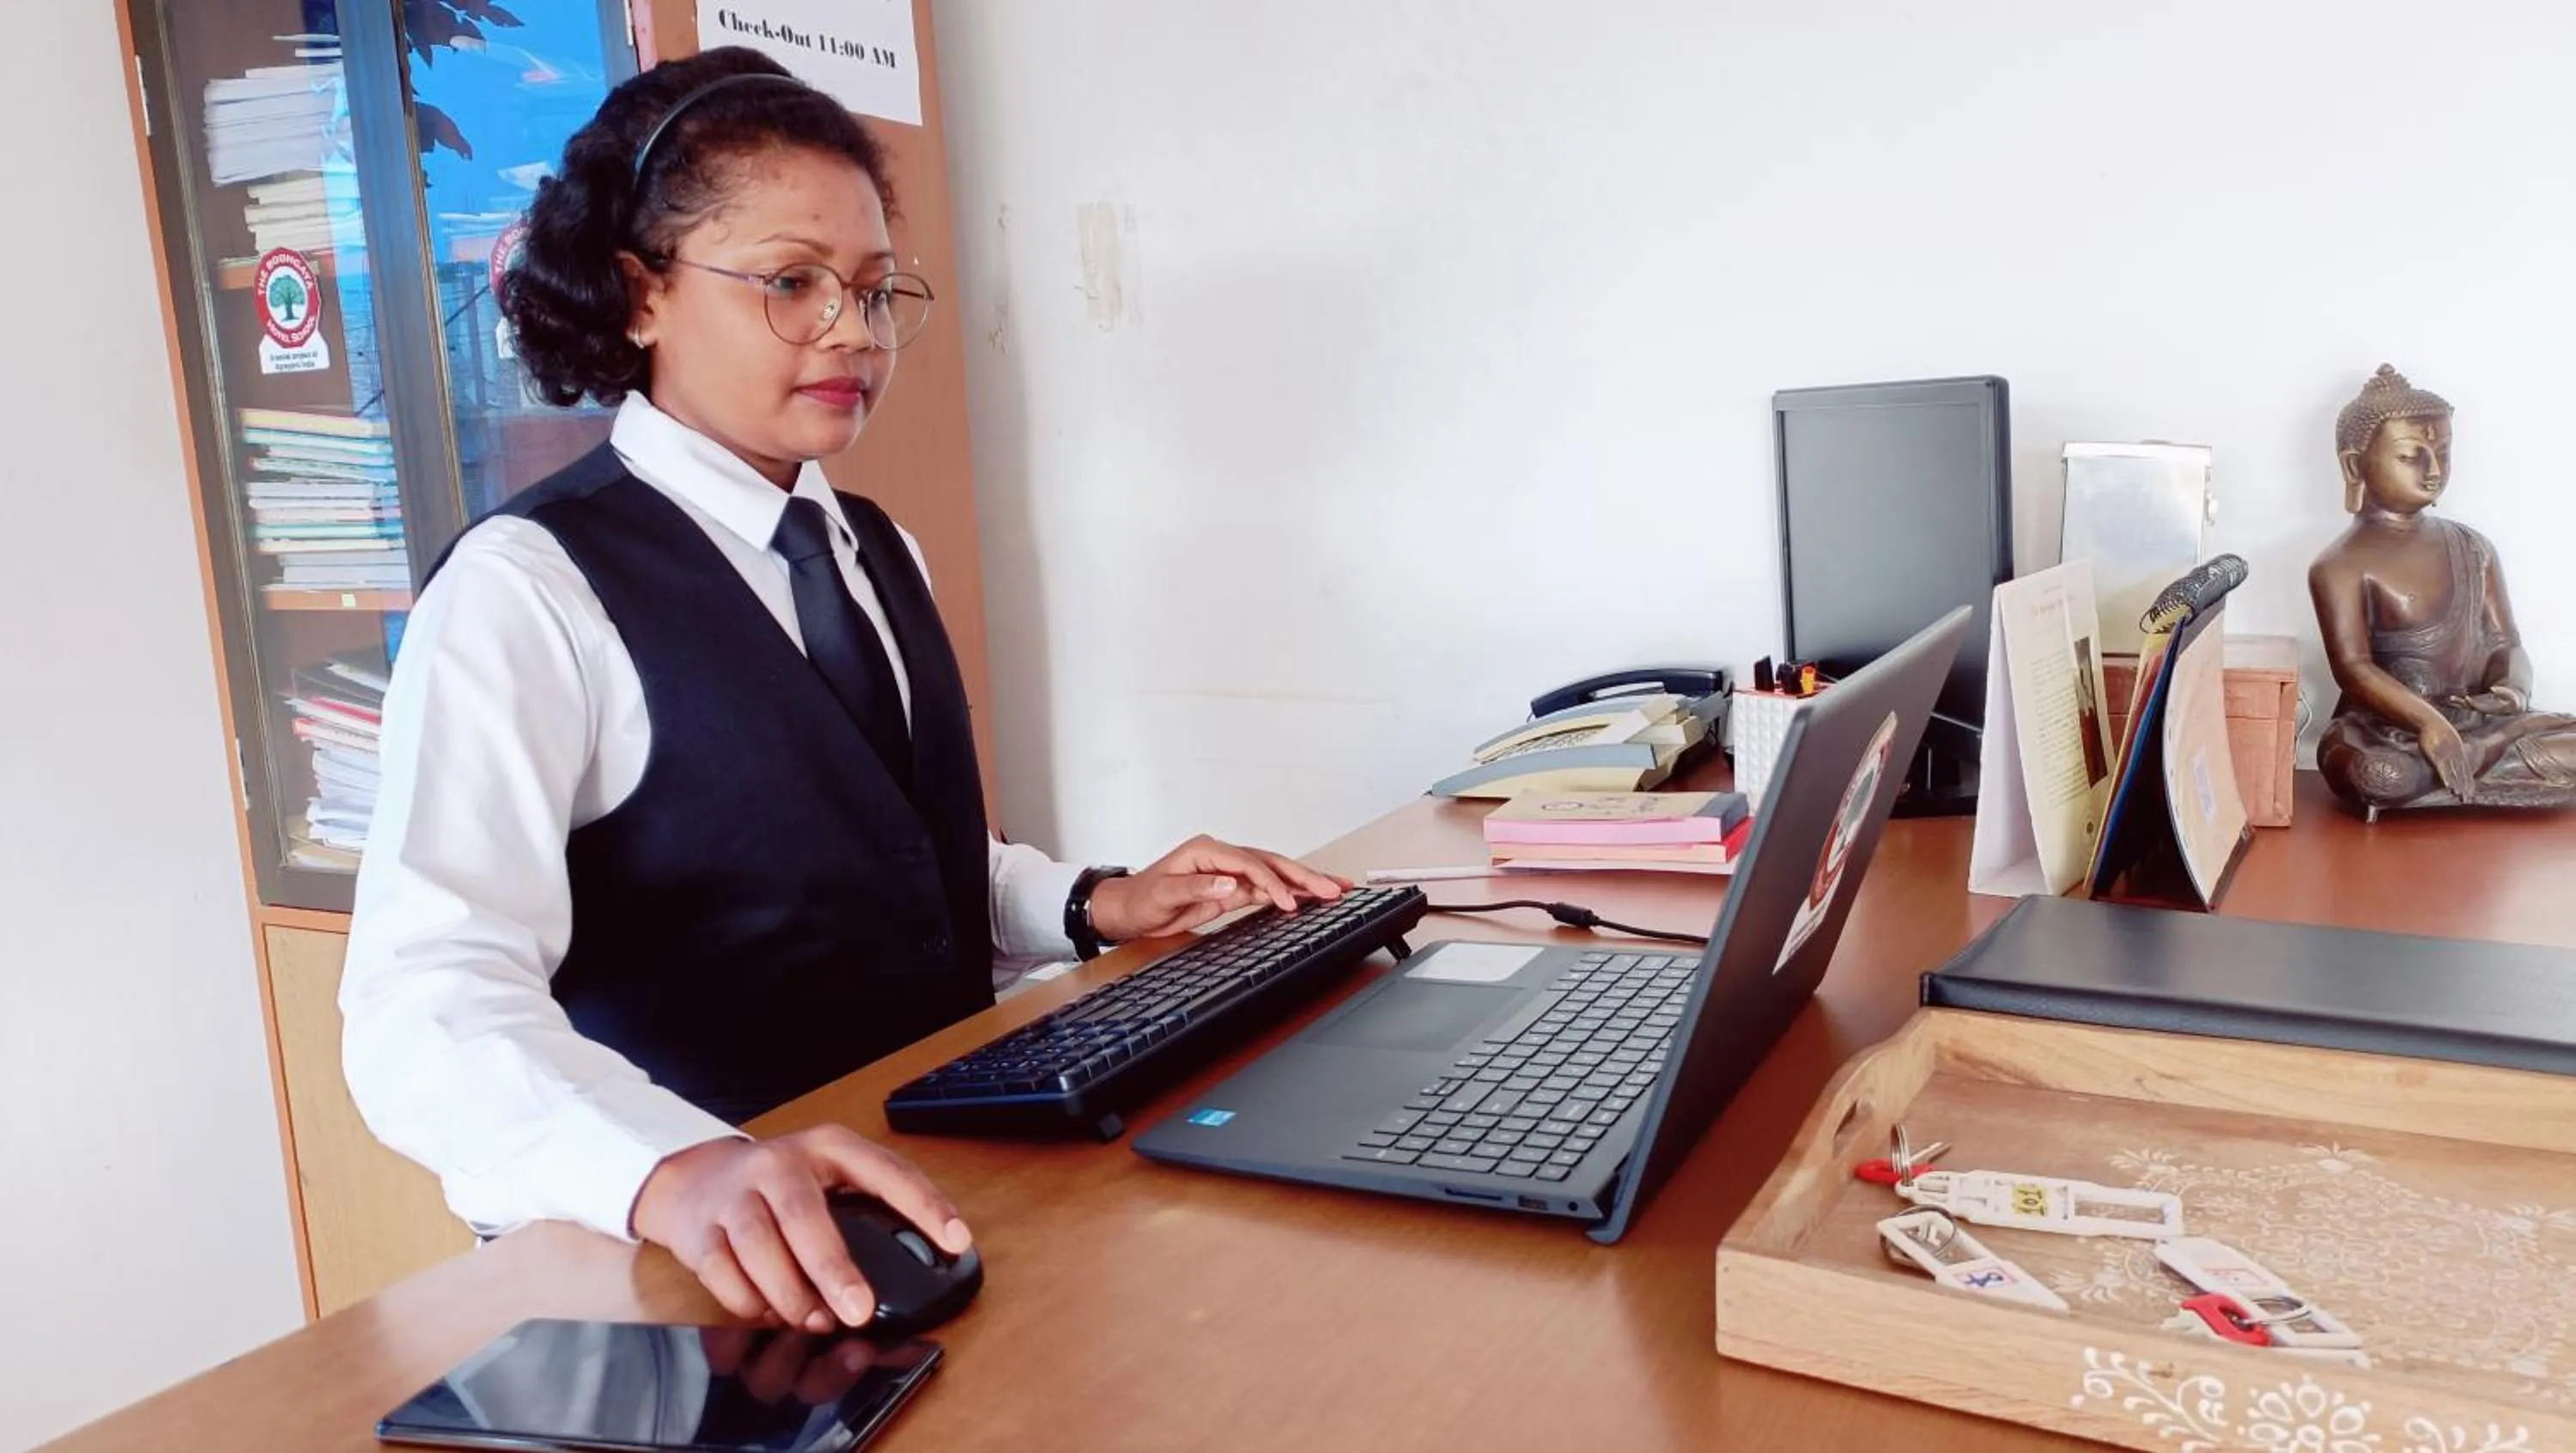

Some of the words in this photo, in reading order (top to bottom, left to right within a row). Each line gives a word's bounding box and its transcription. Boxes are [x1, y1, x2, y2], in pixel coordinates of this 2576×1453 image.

[719, 9, 811, 48] Check-Out
[818, 34, 865, 59] 11:00
[871, 46, 896, 69] AM
